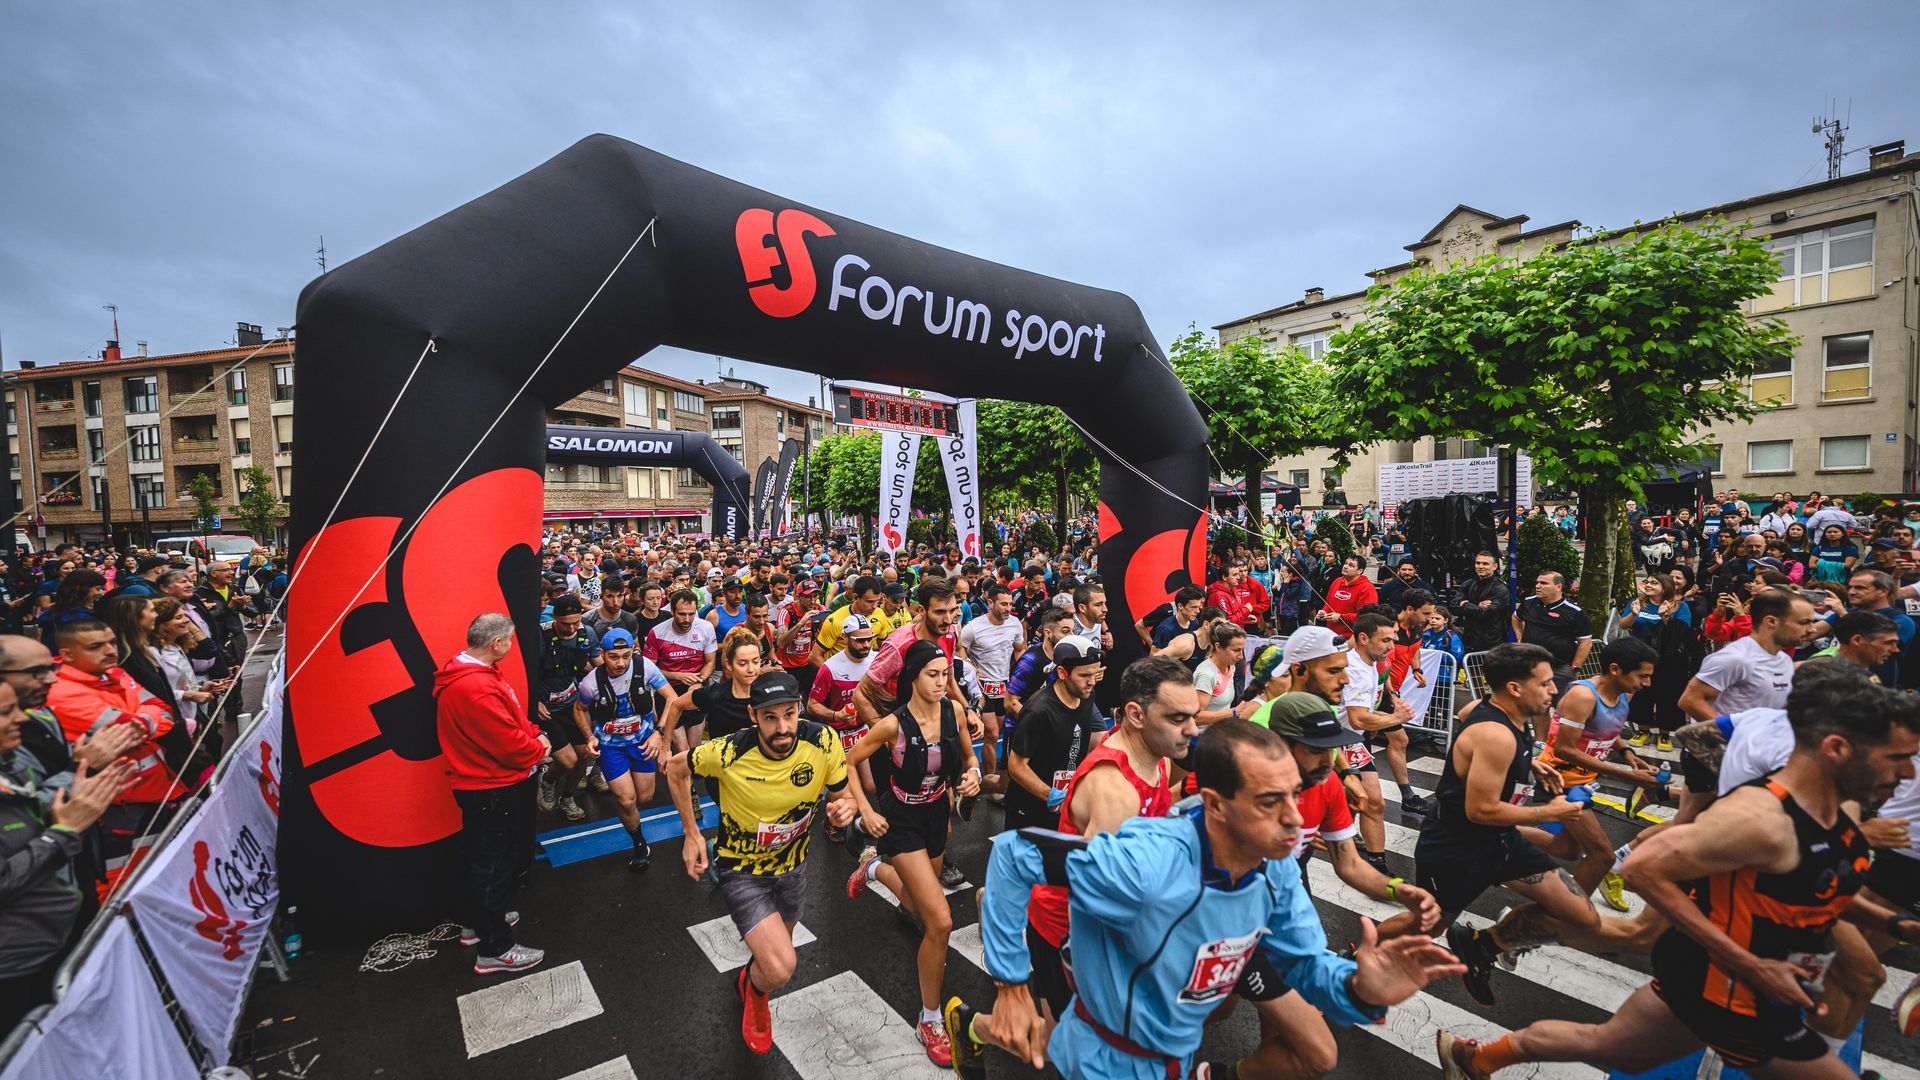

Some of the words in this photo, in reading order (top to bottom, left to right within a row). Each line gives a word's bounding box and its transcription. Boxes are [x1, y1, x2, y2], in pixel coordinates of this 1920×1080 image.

[828, 253, 992, 345] Forum
[1001, 309, 1106, 362] sport
[548, 436, 673, 454] SALOMON
[896, 432, 912, 470] spor
[779, 458, 797, 510] SALOMON
